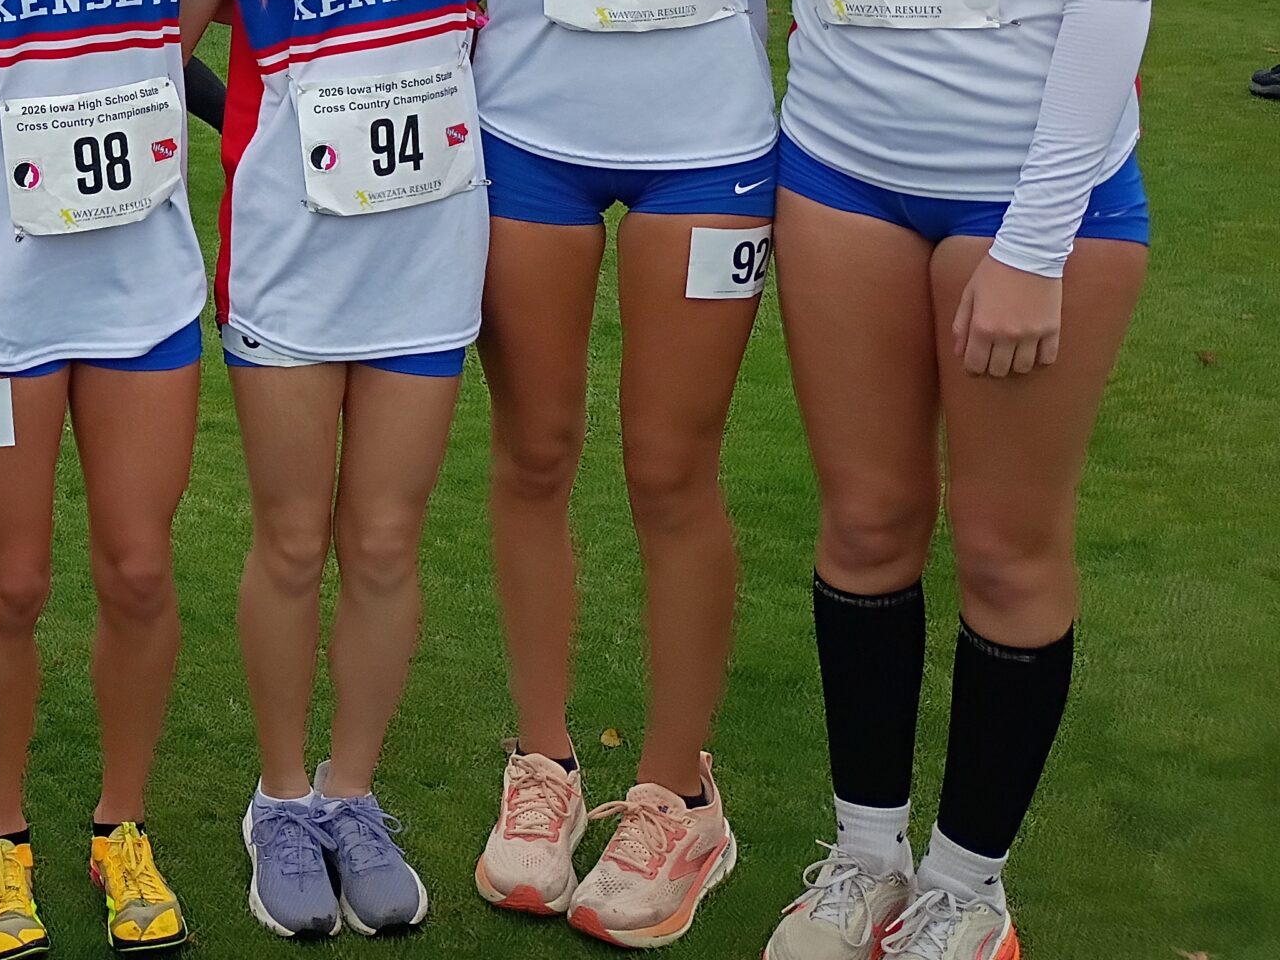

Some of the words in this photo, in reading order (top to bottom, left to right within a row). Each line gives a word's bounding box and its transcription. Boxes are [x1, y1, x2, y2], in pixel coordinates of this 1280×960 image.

[845, 3, 890, 14] WAYZATA
[895, 5, 942, 15] RESULTS
[313, 104, 346, 114] Cross
[349, 98, 391, 111] Country
[393, 84, 458, 106] Championships
[318, 86, 344, 98] 2026
[346, 85, 372, 95] Iowa
[374, 80, 398, 93] High
[400, 75, 434, 89] School
[435, 71, 453, 82] State
[16, 122, 49, 132] Cross
[51, 116, 95, 129] Country
[97, 100, 169, 124] Championships
[21, 104, 47, 116] 2026
[49, 103, 75, 114] Iowa
[78, 98, 102, 111] High
[105, 92, 138, 106] School
[139, 86, 159, 98] State
[370, 113, 424, 177] 94
[73, 131, 132, 195] 98
[368, 187, 407, 200] WAYZATA
[409, 179, 442, 193] RESULTS
[72, 206, 117, 219] WAYZATA
[119, 197, 152, 212] RESULTS
[732, 237, 770, 284] 92
